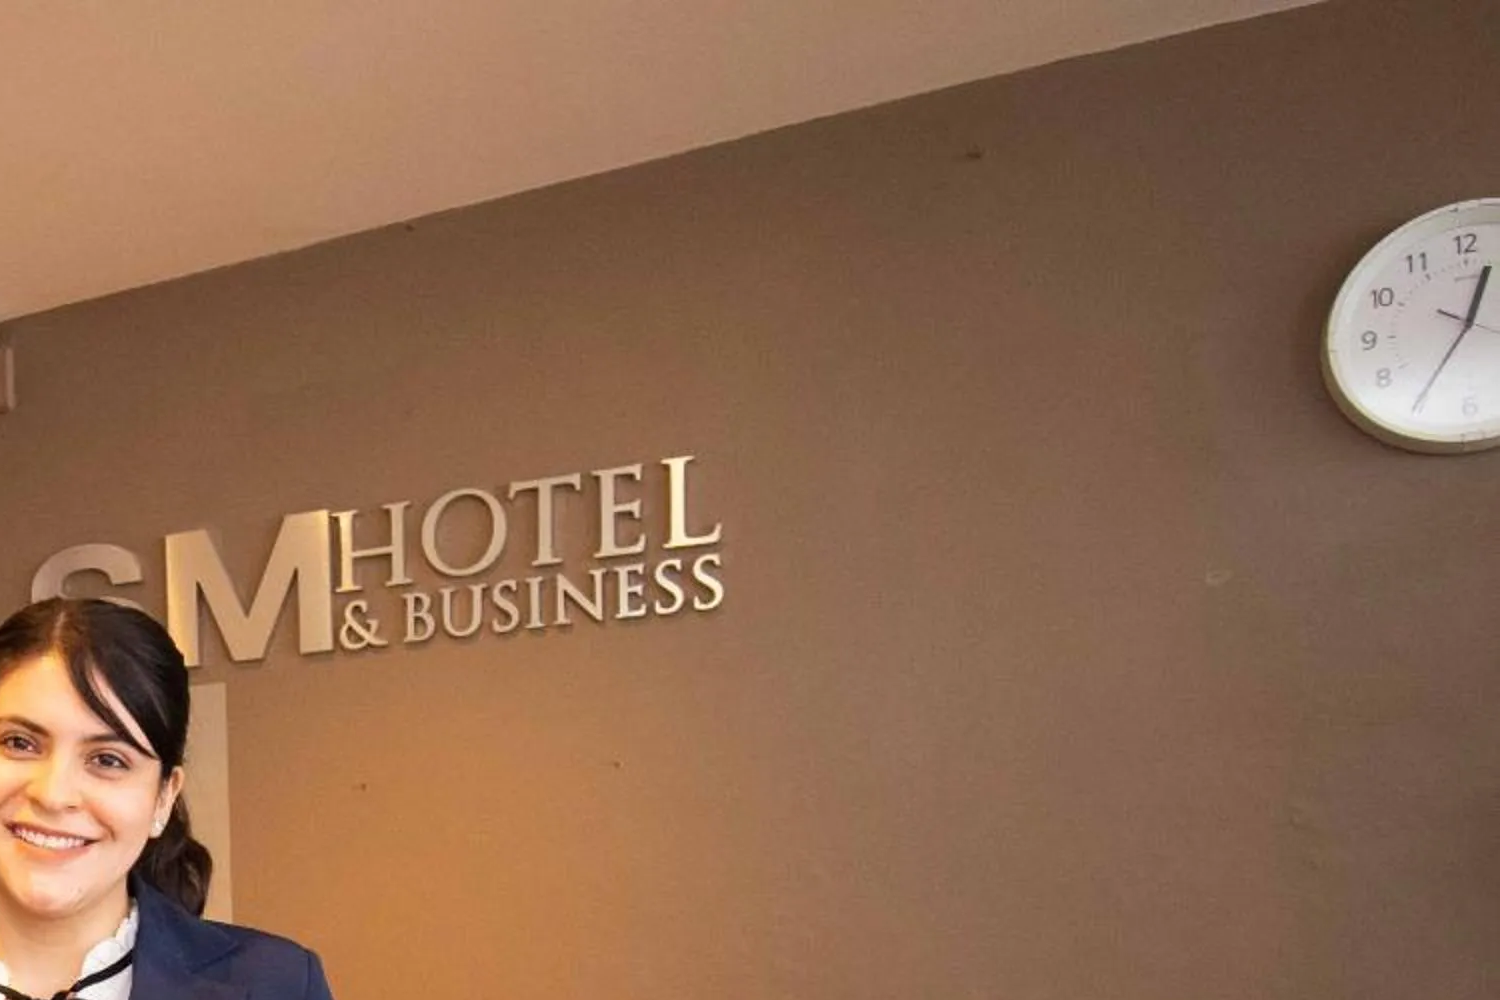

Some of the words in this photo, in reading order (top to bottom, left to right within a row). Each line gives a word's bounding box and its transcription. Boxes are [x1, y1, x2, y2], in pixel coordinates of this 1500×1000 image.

[1453, 233, 1477, 255] 12
[1405, 252, 1427, 273] 11
[1371, 287, 1394, 309] 10
[1361, 330, 1378, 351] 9
[1376, 367, 1392, 389] 8
[332, 455, 722, 593] HOTEL
[339, 599, 389, 651] &
[403, 553, 724, 644] BUSINESS
